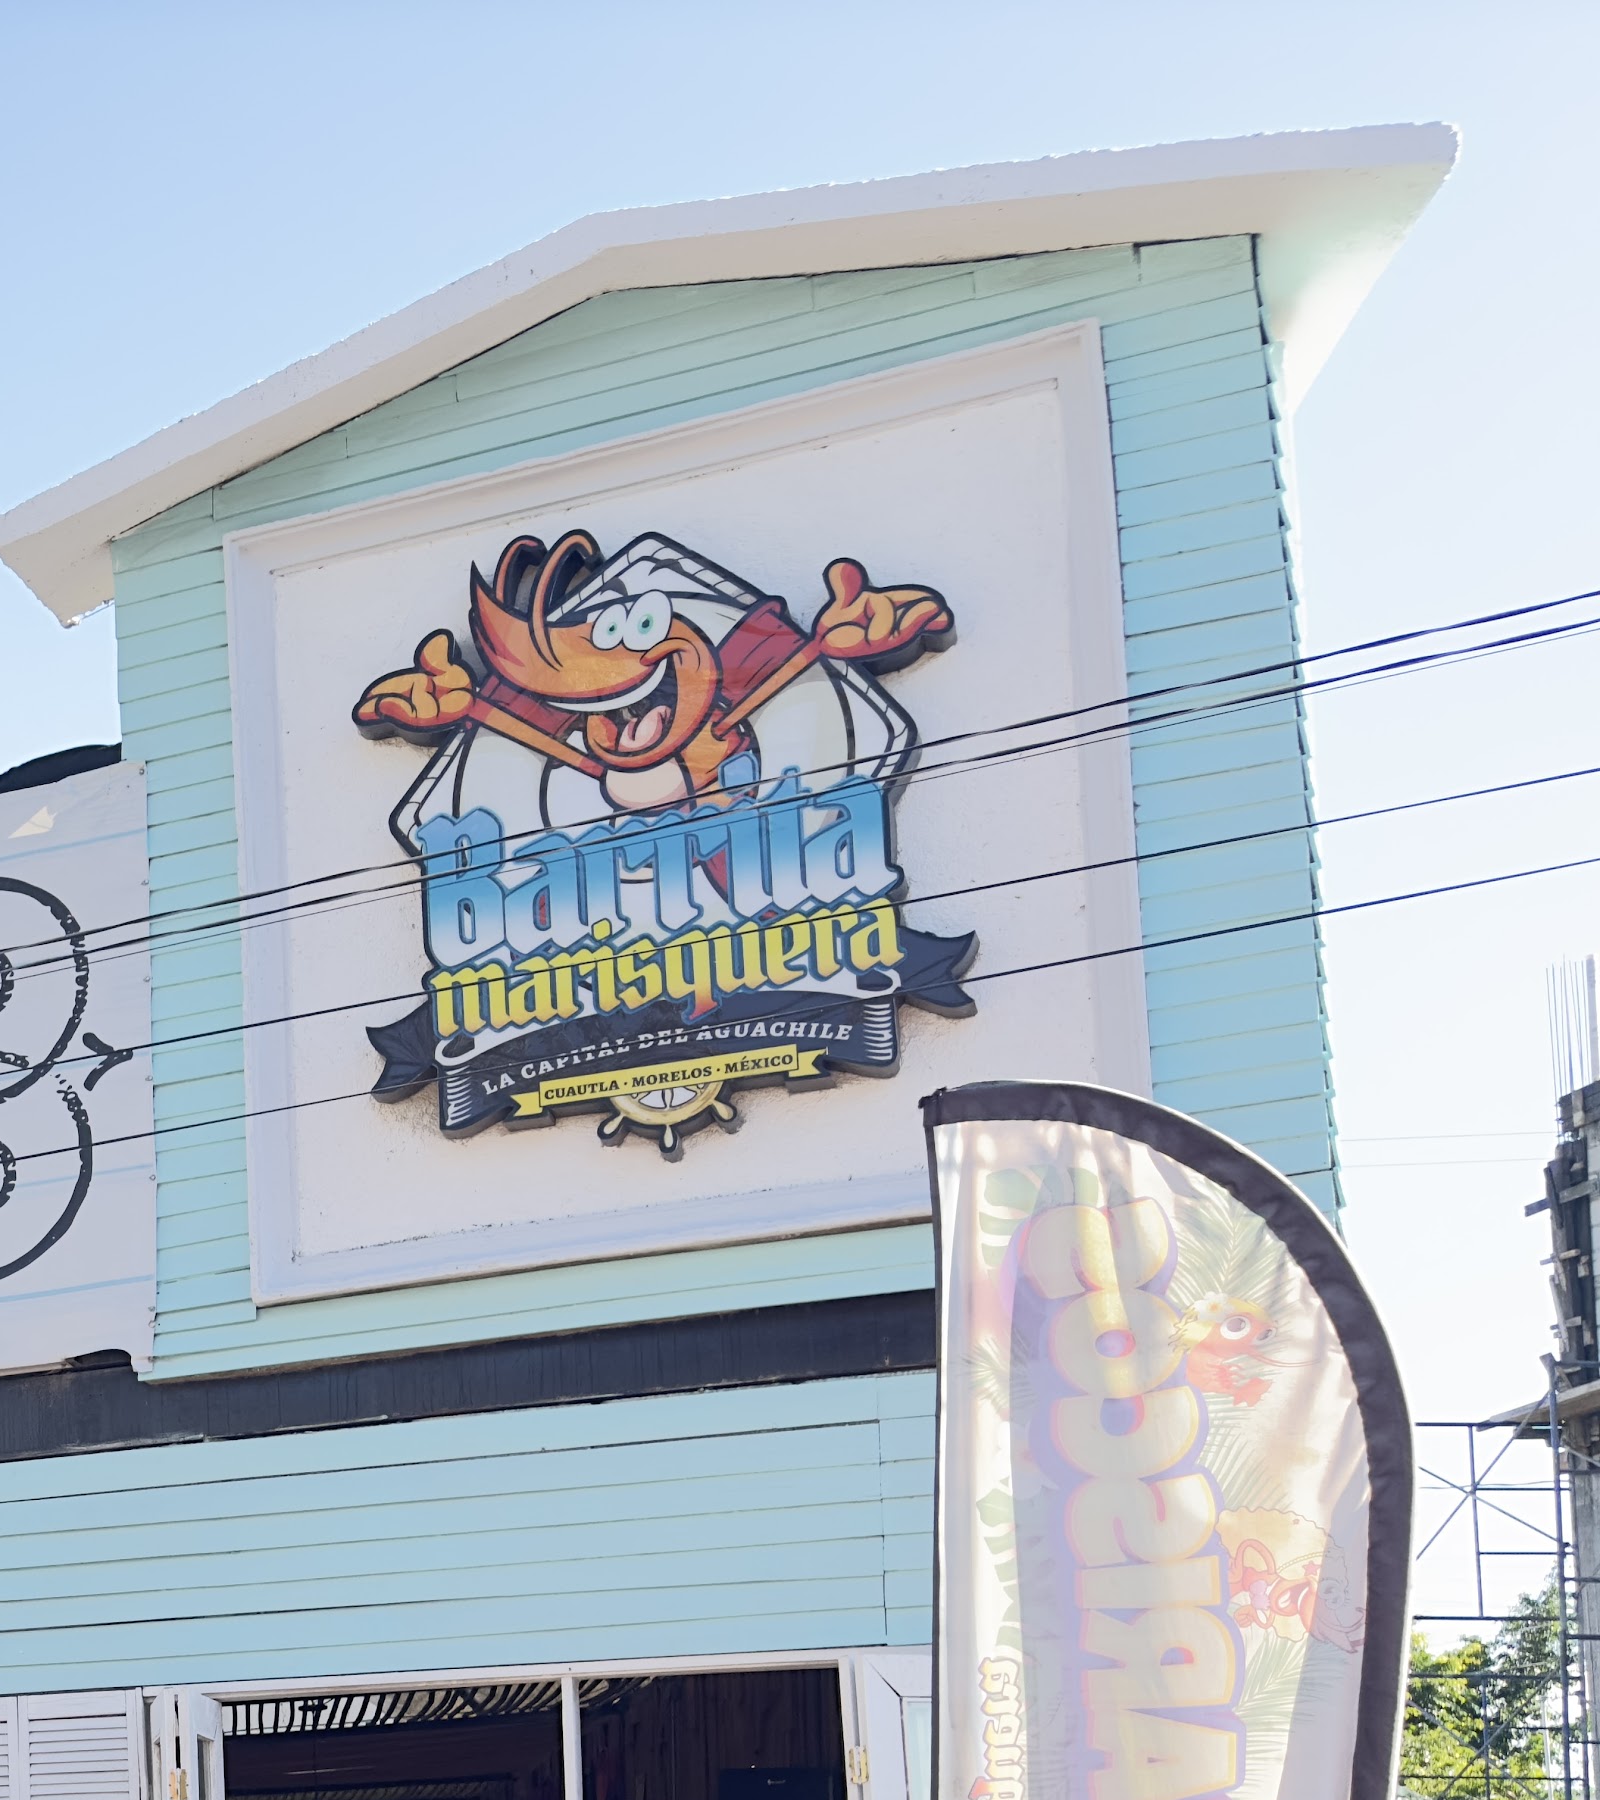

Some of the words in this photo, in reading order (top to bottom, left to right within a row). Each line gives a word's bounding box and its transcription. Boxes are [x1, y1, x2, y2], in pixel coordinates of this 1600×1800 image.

[415, 751, 902, 967] Barrita
[425, 896, 905, 1038] marisquera
[482, 1072, 514, 1096] LA
[519, 1039, 625, 1080] CAPITAL
[637, 1029, 689, 1055] DEL
[696, 1021, 853, 1042] AGUACHILE
[544, 1081, 620, 1100] CUAUTLA
[631, 1065, 712, 1088] MORELOS
[724, 1053, 793, 1075] MÉXICO
